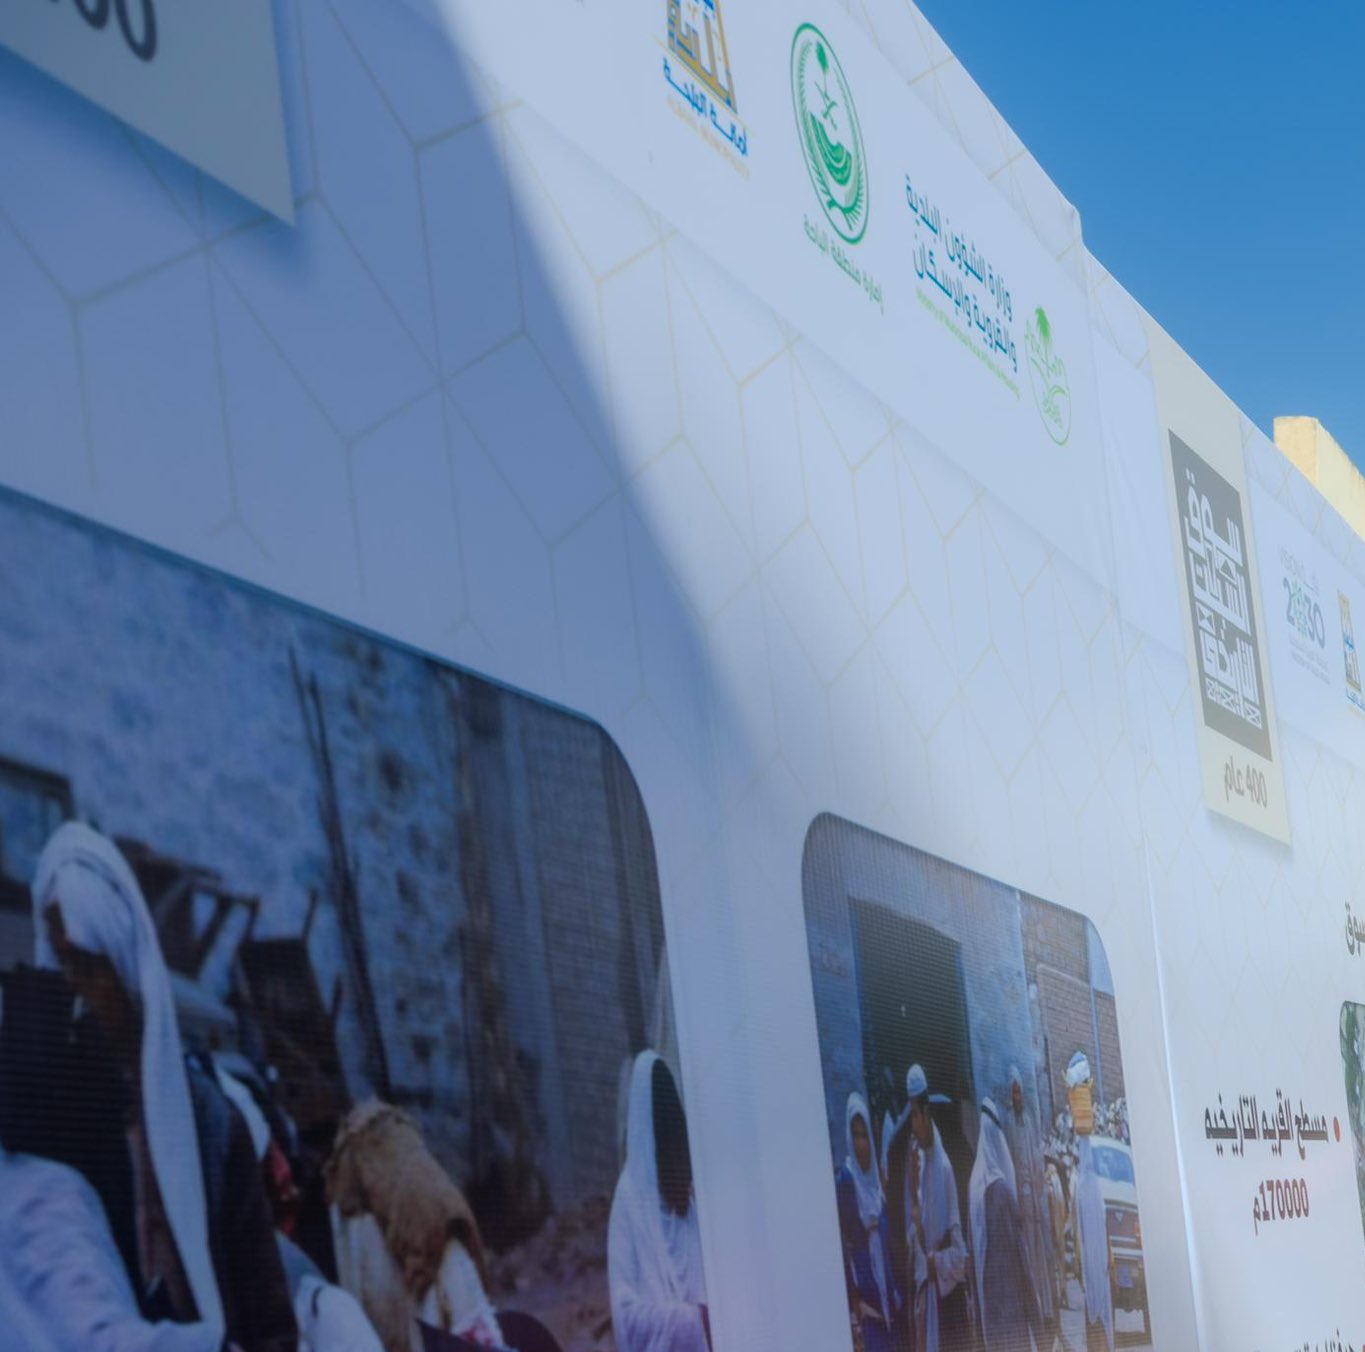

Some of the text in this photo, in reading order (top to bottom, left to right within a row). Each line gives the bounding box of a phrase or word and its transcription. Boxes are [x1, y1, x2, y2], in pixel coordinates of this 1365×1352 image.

[904, 173, 942, 244] البلدية
[987, 262, 1013, 324] وزارة
[973, 293, 1018, 374] والقروية
[1246, 763, 1268, 808] 400
[1294, 1098, 1329, 1161] مسطح
